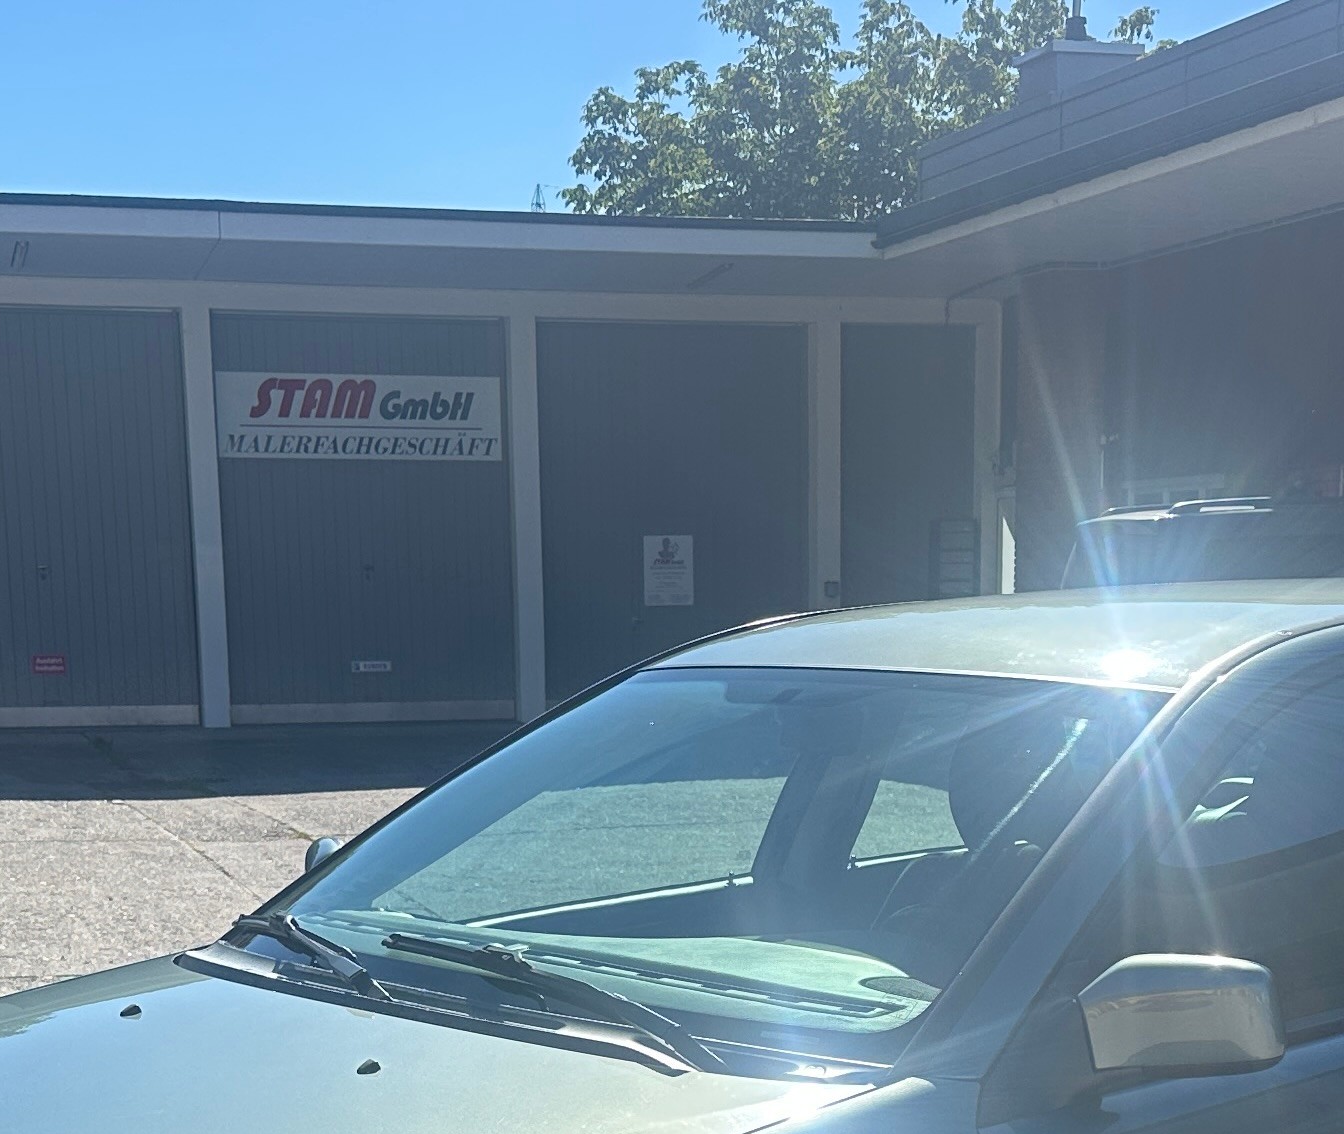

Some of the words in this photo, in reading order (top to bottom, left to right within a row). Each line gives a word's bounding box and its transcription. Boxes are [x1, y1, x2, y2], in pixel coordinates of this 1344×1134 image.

[249, 376, 377, 419] STAM
[379, 389, 475, 421] GmbH
[225, 431, 498, 457] MALERFACHGESCHÄFT
